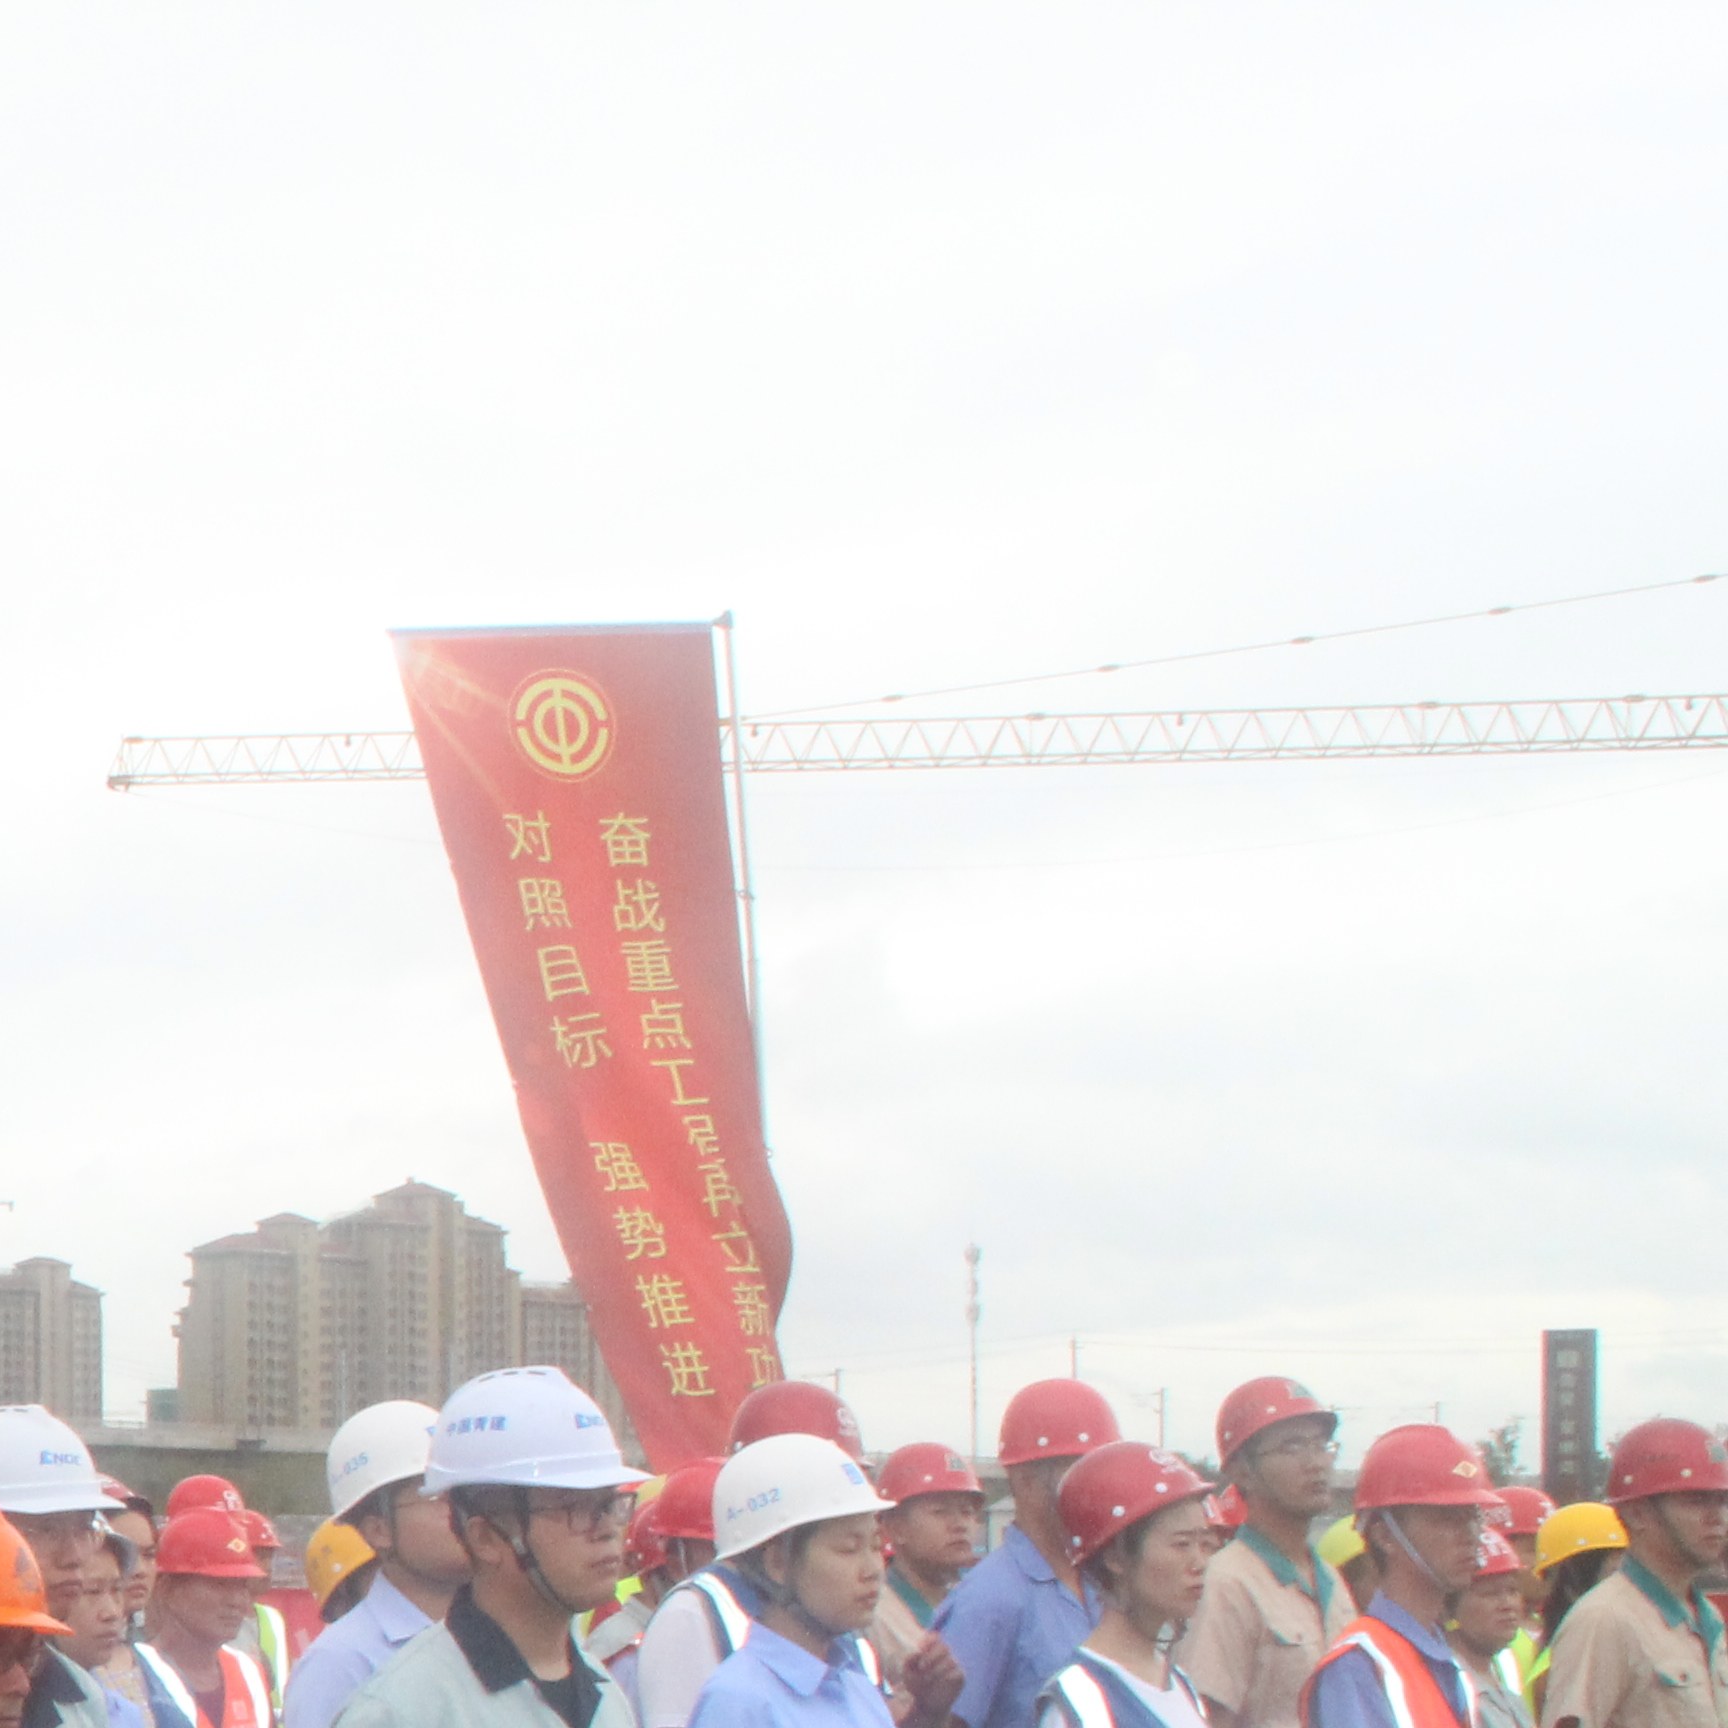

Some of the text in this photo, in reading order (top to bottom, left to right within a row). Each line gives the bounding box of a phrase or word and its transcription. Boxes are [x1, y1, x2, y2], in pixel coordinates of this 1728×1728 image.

[502, 810, 716, 1397] 对照目标 强势推进
